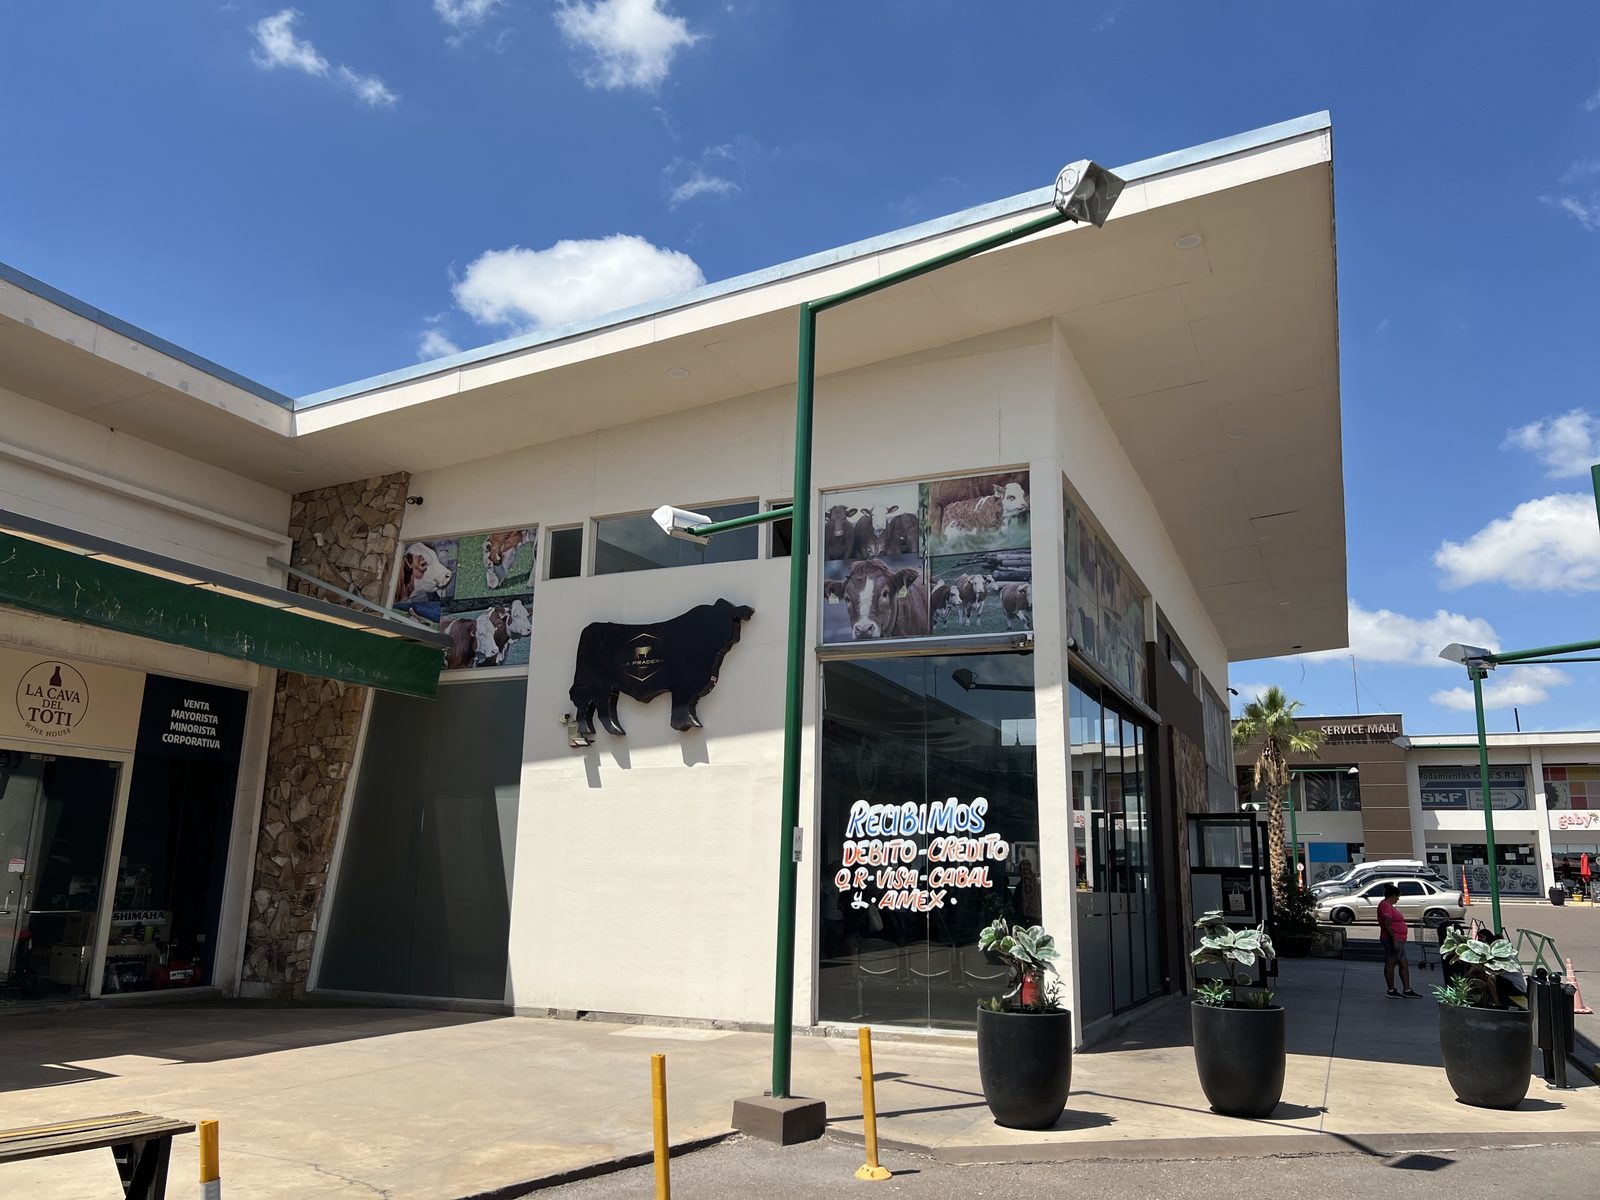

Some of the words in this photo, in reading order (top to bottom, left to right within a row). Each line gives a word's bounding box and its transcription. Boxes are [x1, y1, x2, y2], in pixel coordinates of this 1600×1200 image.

[632, 658, 665, 666] PRADERA
[25, 684, 43, 698] LA
[47, 687, 80, 703] CAVA
[42, 699, 63, 710] DEL
[183, 698, 210, 711] VENTA
[28, 707, 72, 727] TOTI
[171, 709, 219, 725] MAYORISTA
[25, 721, 43, 736] WINE
[46, 727, 71, 737] HOUSE
[170, 721, 216, 737] MINORISTA
[1321, 724, 1364, 735] SERVICE
[1367, 723, 1399, 734] MALL
[162, 733, 221, 749] CORPORATIVA
[1496, 771, 1521, 779] S.R.L.
[1422, 792, 1462, 803] SKF
[845, 797, 989, 838] RECIBIMOS
[1559, 813, 1593, 830] gaby
[112, 911, 165, 921] SHIMAHA
